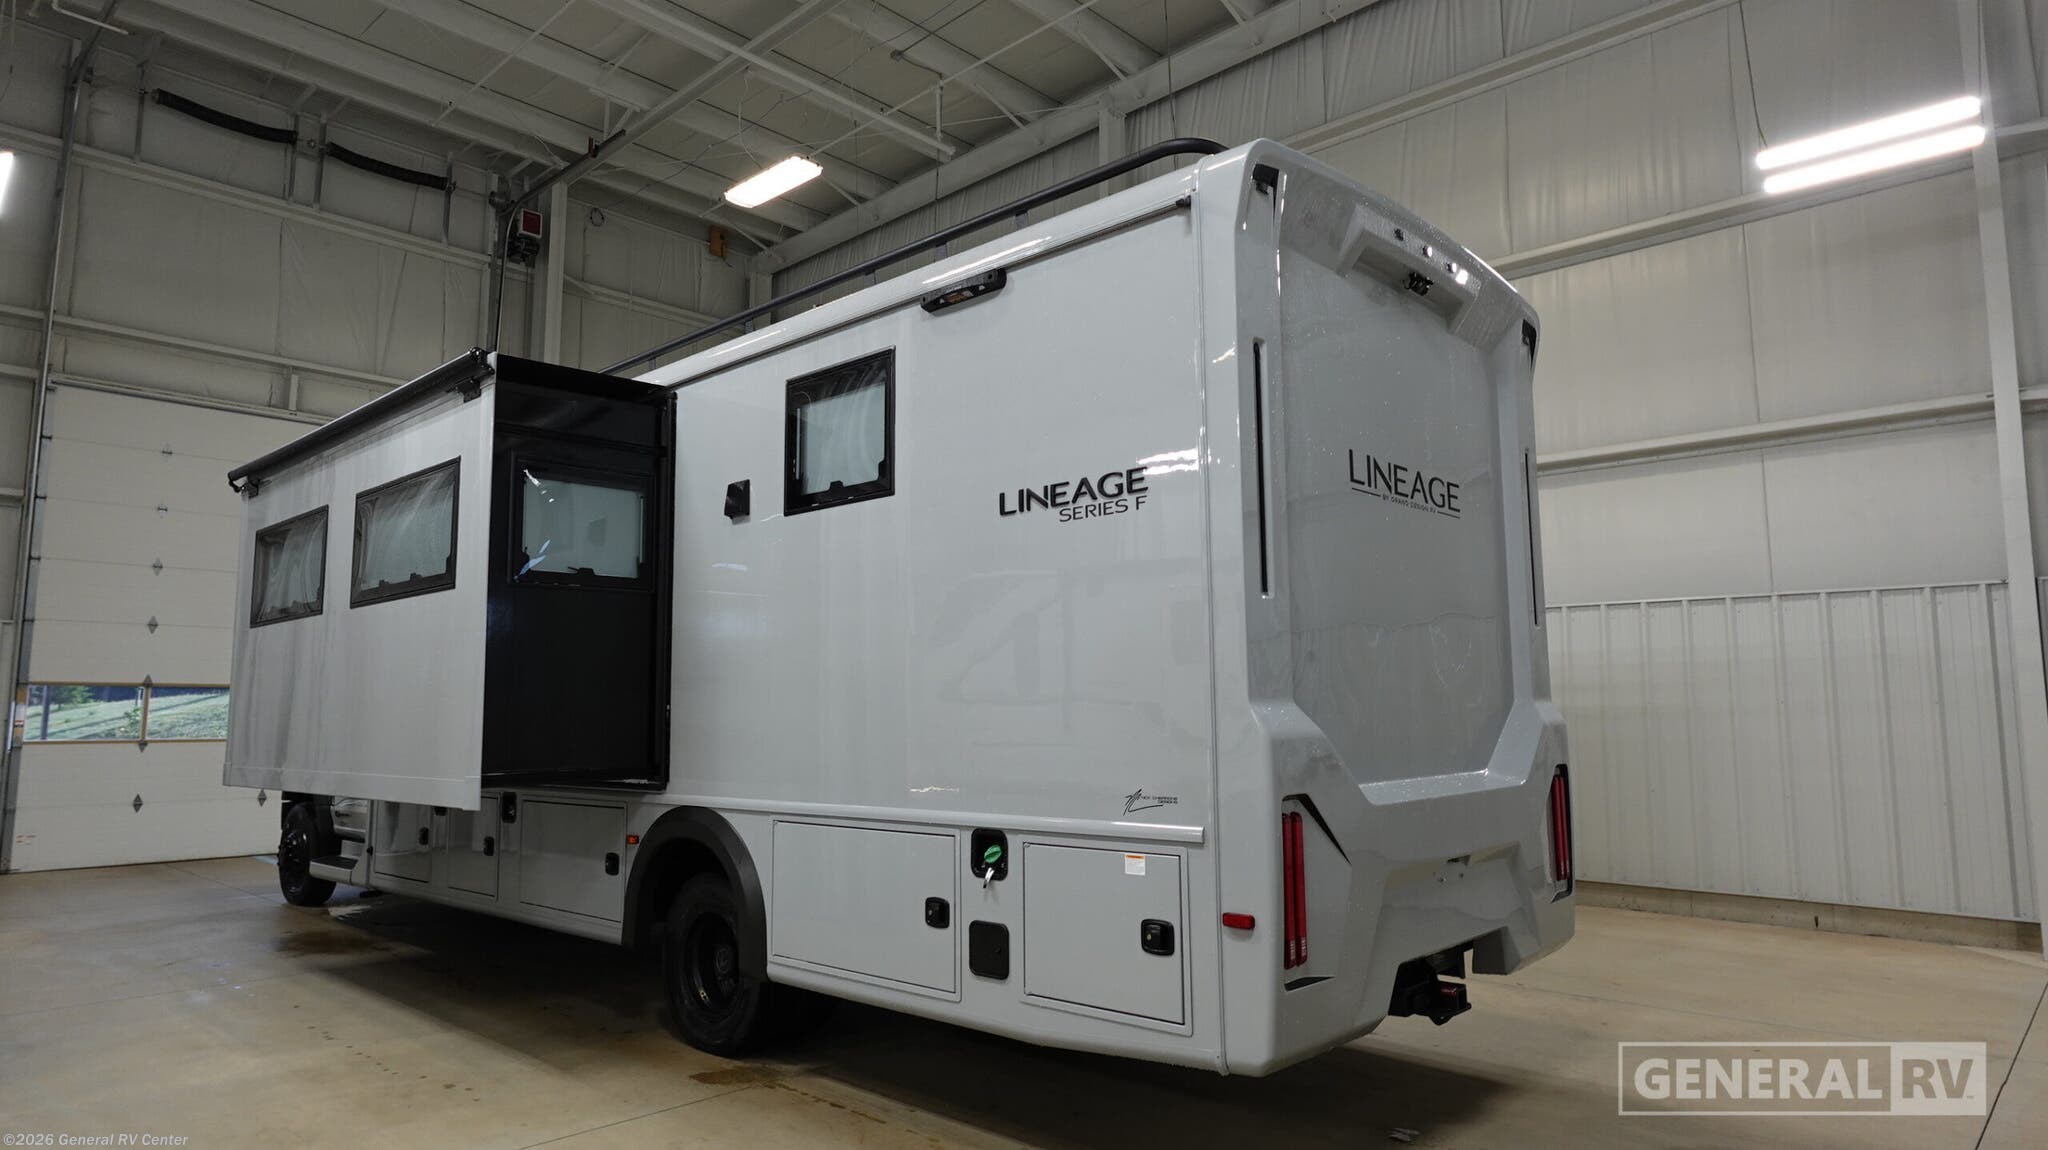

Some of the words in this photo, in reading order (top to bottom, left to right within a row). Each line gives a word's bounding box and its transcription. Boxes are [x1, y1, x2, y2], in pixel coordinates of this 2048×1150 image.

[999, 466, 1148, 516] LINEAGE
[1349, 449, 1461, 513] LINEAGE
[1059, 498, 1128, 522] SERIES
[1136, 495, 1147, 510] F
